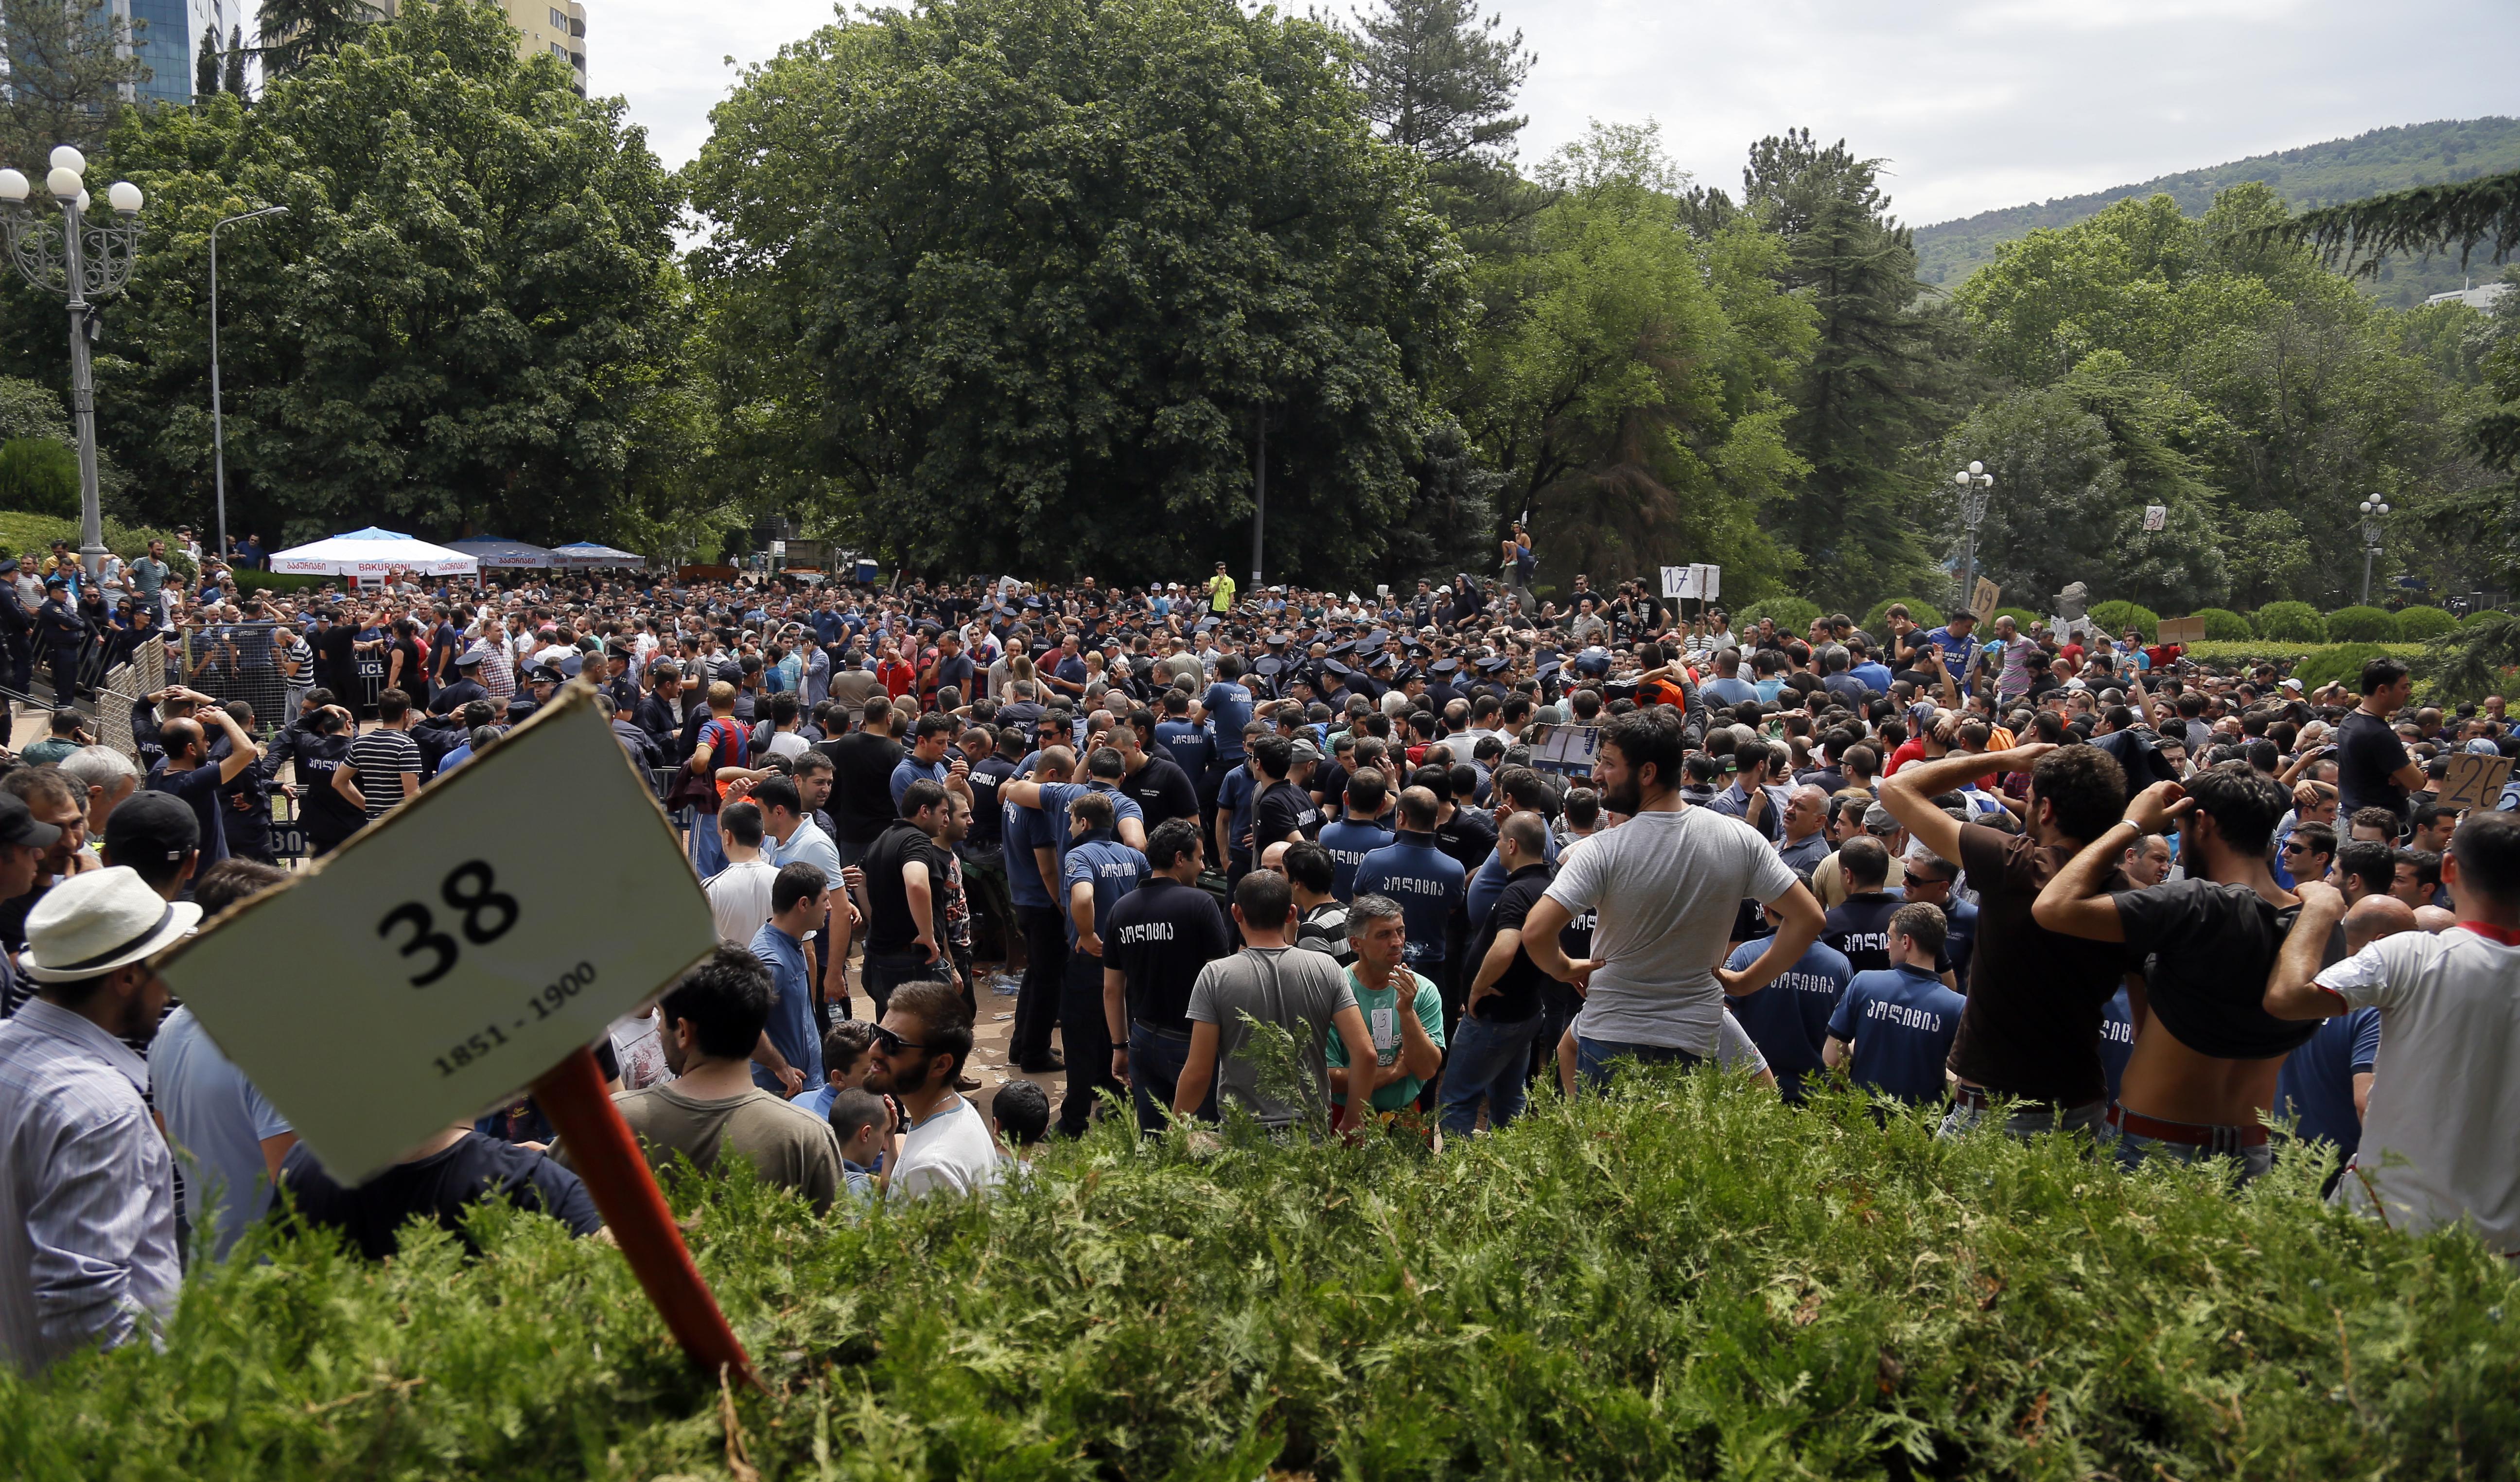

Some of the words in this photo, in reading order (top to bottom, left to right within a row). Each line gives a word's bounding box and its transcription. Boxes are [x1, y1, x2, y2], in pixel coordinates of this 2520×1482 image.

[2145, 511, 2164, 527] 61
[287, 562, 326, 571] ბაკურიანი
[438, 562, 468, 571] ბაკურიანი
[1664, 568, 1689, 594] 17
[1975, 587, 1993, 614] 19
[359, 664, 384, 674] ICE
[1172, 735, 1203, 744] პოლიცია
[2450, 756, 2507, 807] 26
[1100, 862, 1136, 878] პოლიცია
[1383, 876, 1444, 896] პოლიცია
[376, 859, 520, 988] 38
[1120, 922, 1173, 944] პოლიცია
[433, 1023, 509, 1077] 1851
[527, 959, 597, 1022] 1900
[1867, 999, 1940, 1032] პოლიცია
